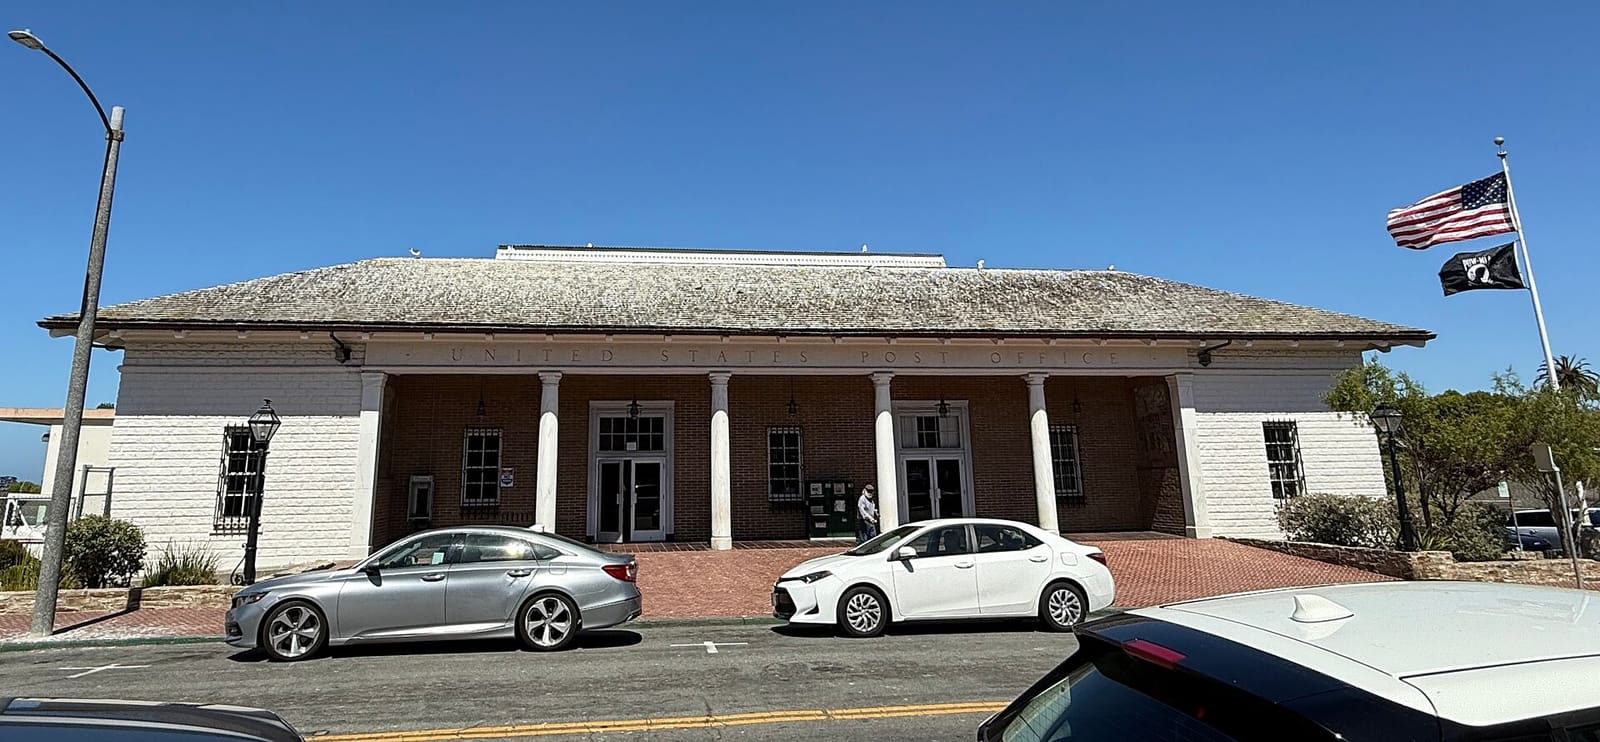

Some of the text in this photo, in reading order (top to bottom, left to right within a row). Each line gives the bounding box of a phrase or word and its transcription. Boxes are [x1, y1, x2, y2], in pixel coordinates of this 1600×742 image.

[451, 349, 1118, 365] UNITED STATES POST OFFICE
